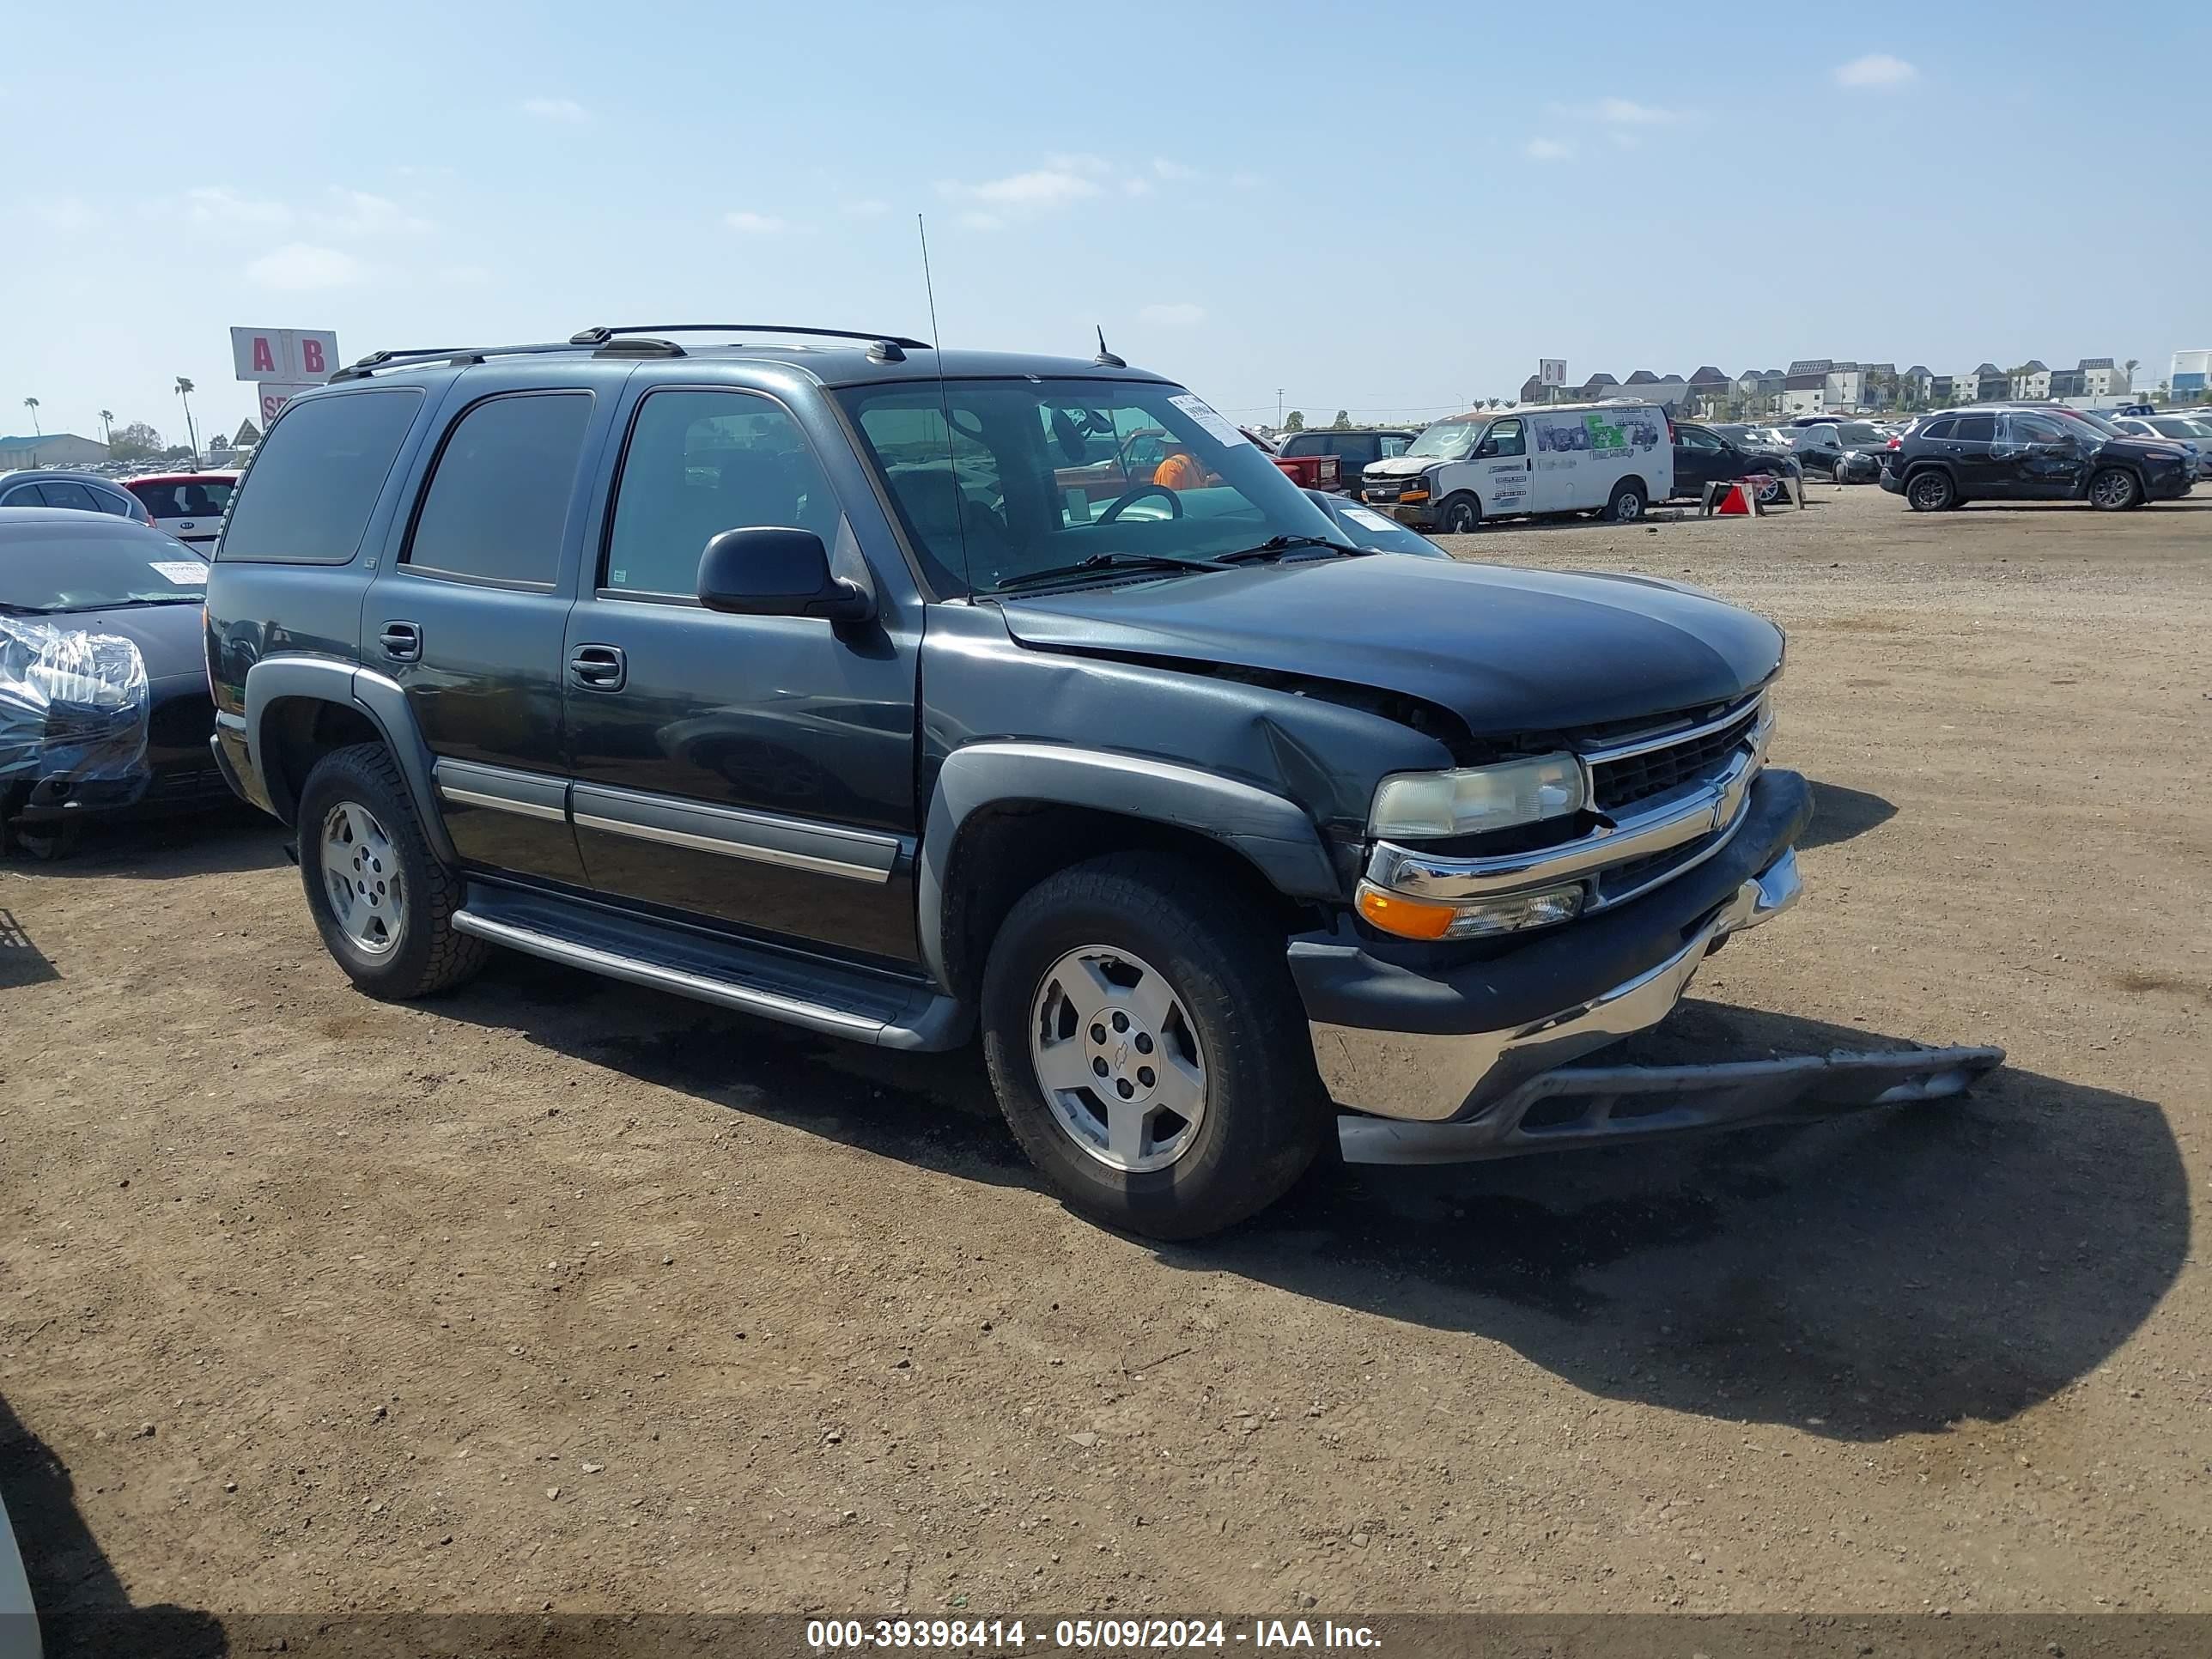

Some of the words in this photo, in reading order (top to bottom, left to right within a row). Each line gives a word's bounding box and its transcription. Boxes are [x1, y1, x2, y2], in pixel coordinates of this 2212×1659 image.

[253, 337, 276, 372] A
[301, 339, 325, 373] B
[1546, 363, 1552, 381] C
[1558, 363, 1564, 380] D
[364, 558, 376, 568] LT
